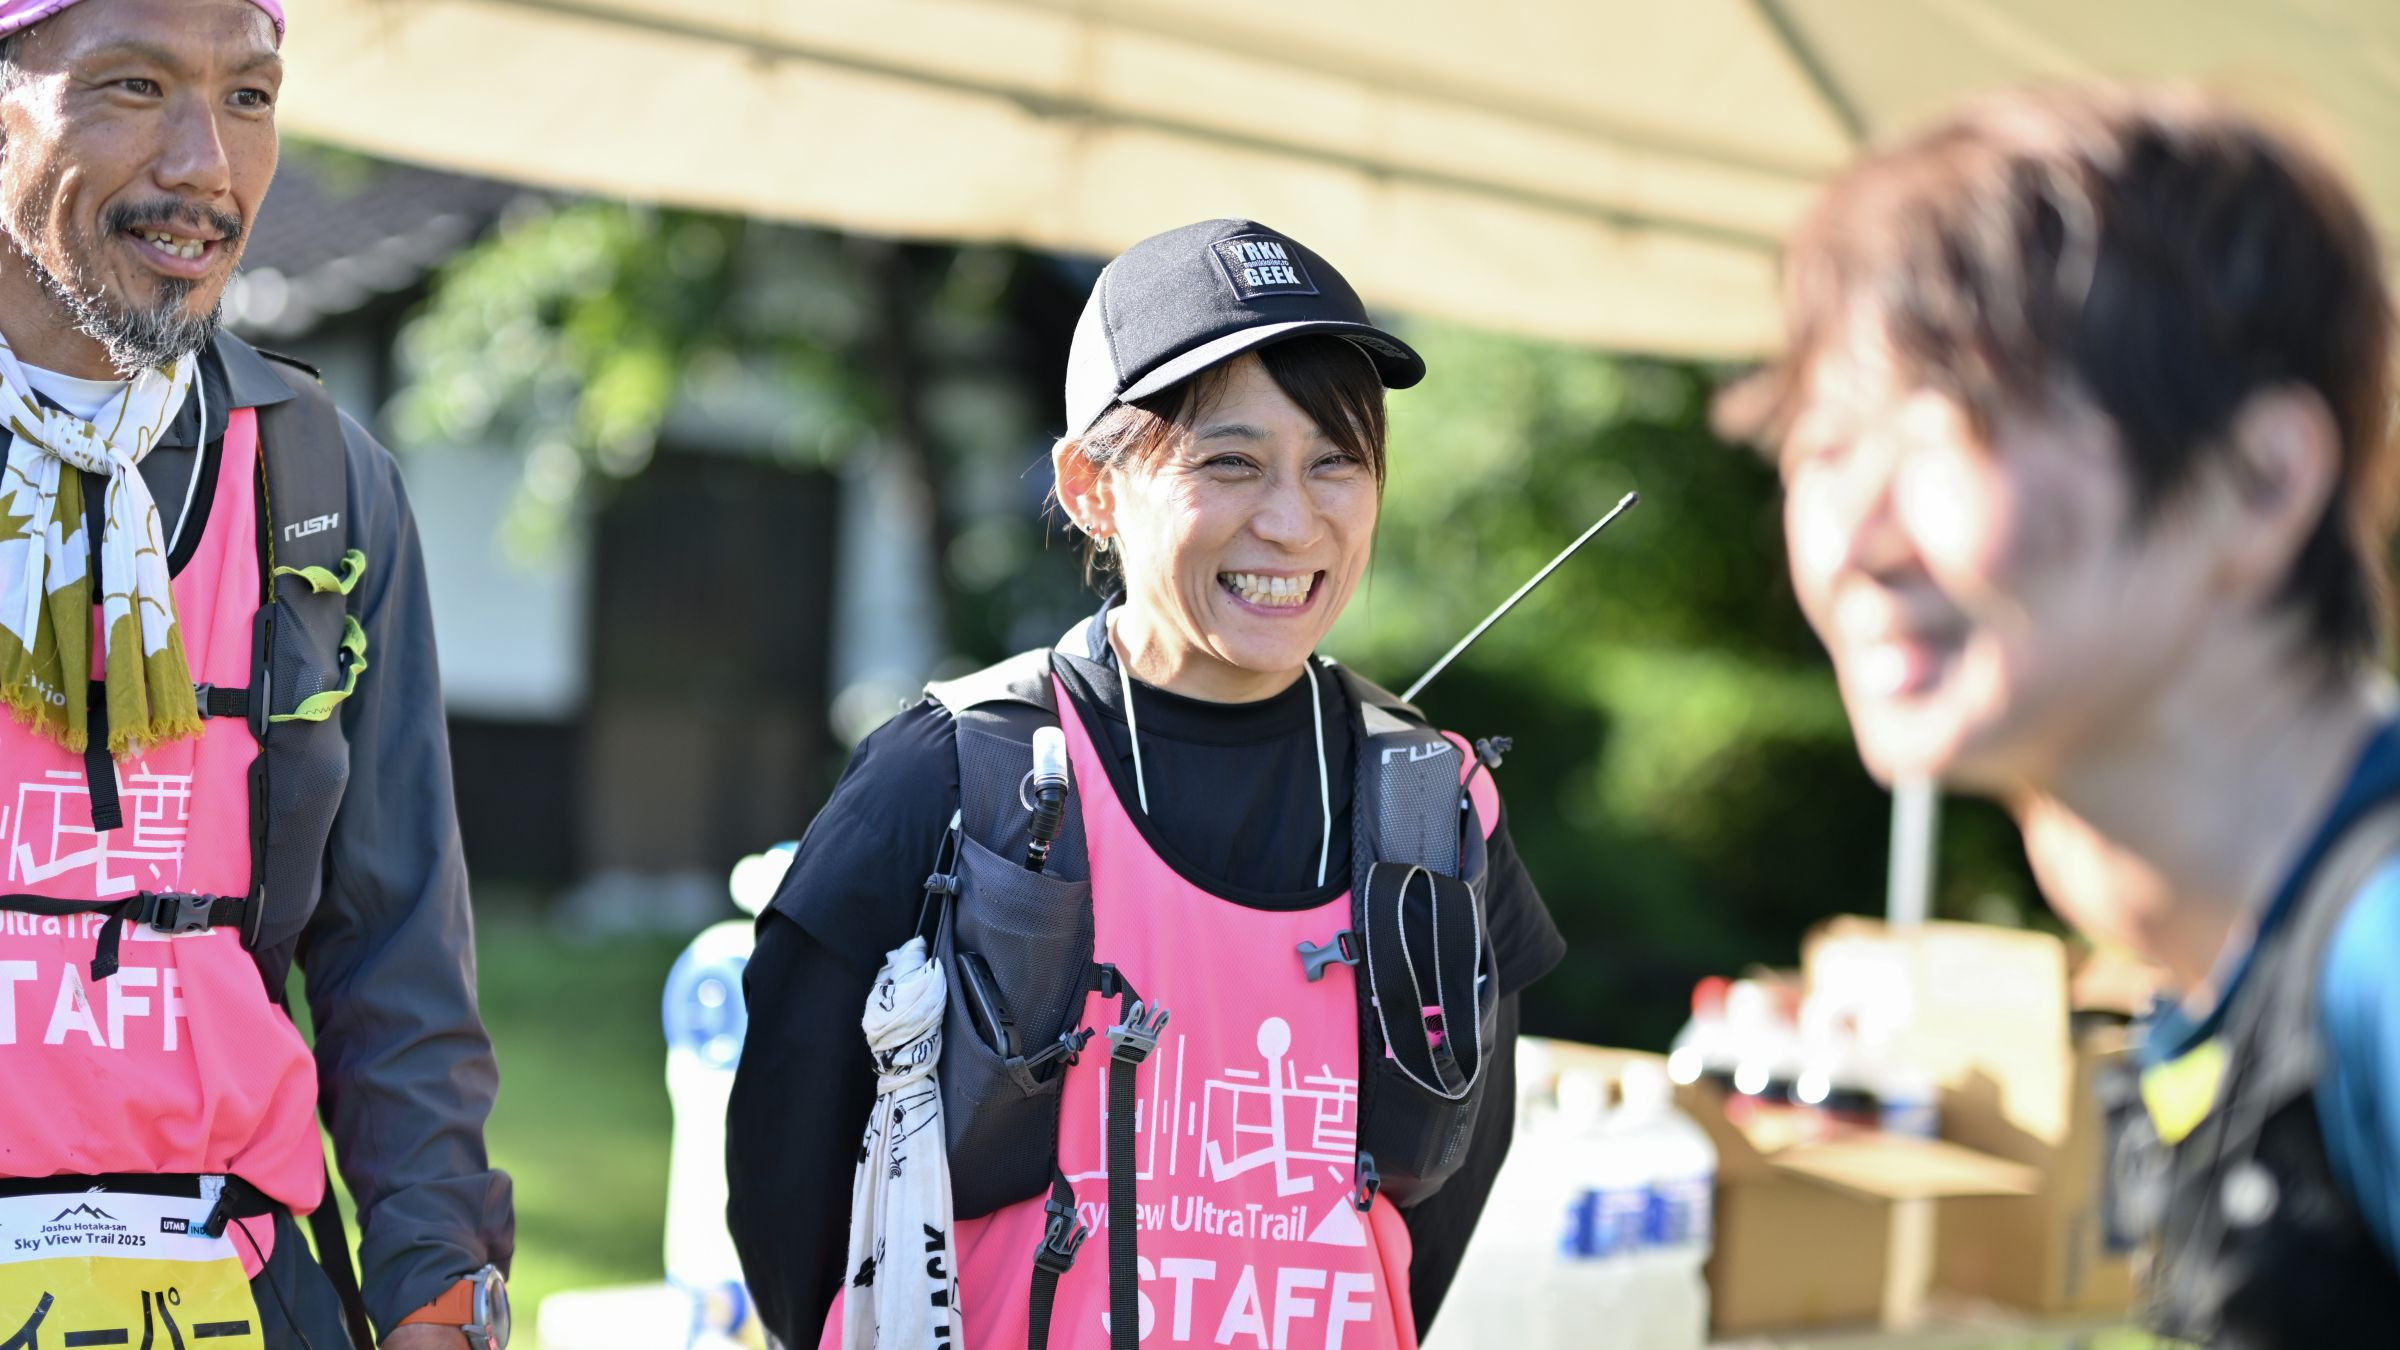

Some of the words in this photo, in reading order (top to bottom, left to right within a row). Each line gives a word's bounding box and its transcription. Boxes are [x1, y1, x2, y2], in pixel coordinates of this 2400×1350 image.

[1229, 241, 1288, 263] YRKN
[1244, 266, 1301, 286] GEEK
[40, 1224, 71, 1233] Joshu
[74, 1223, 127, 1232] Hotaka-san
[163, 1221, 187, 1231] UTMB
[190, 1226, 206, 1235] IND
[14, 1238, 41, 1251] Sky
[45, 1234, 82, 1246] View
[86, 1233, 115, 1244] Trail
[117, 1234, 146, 1246] 2025
